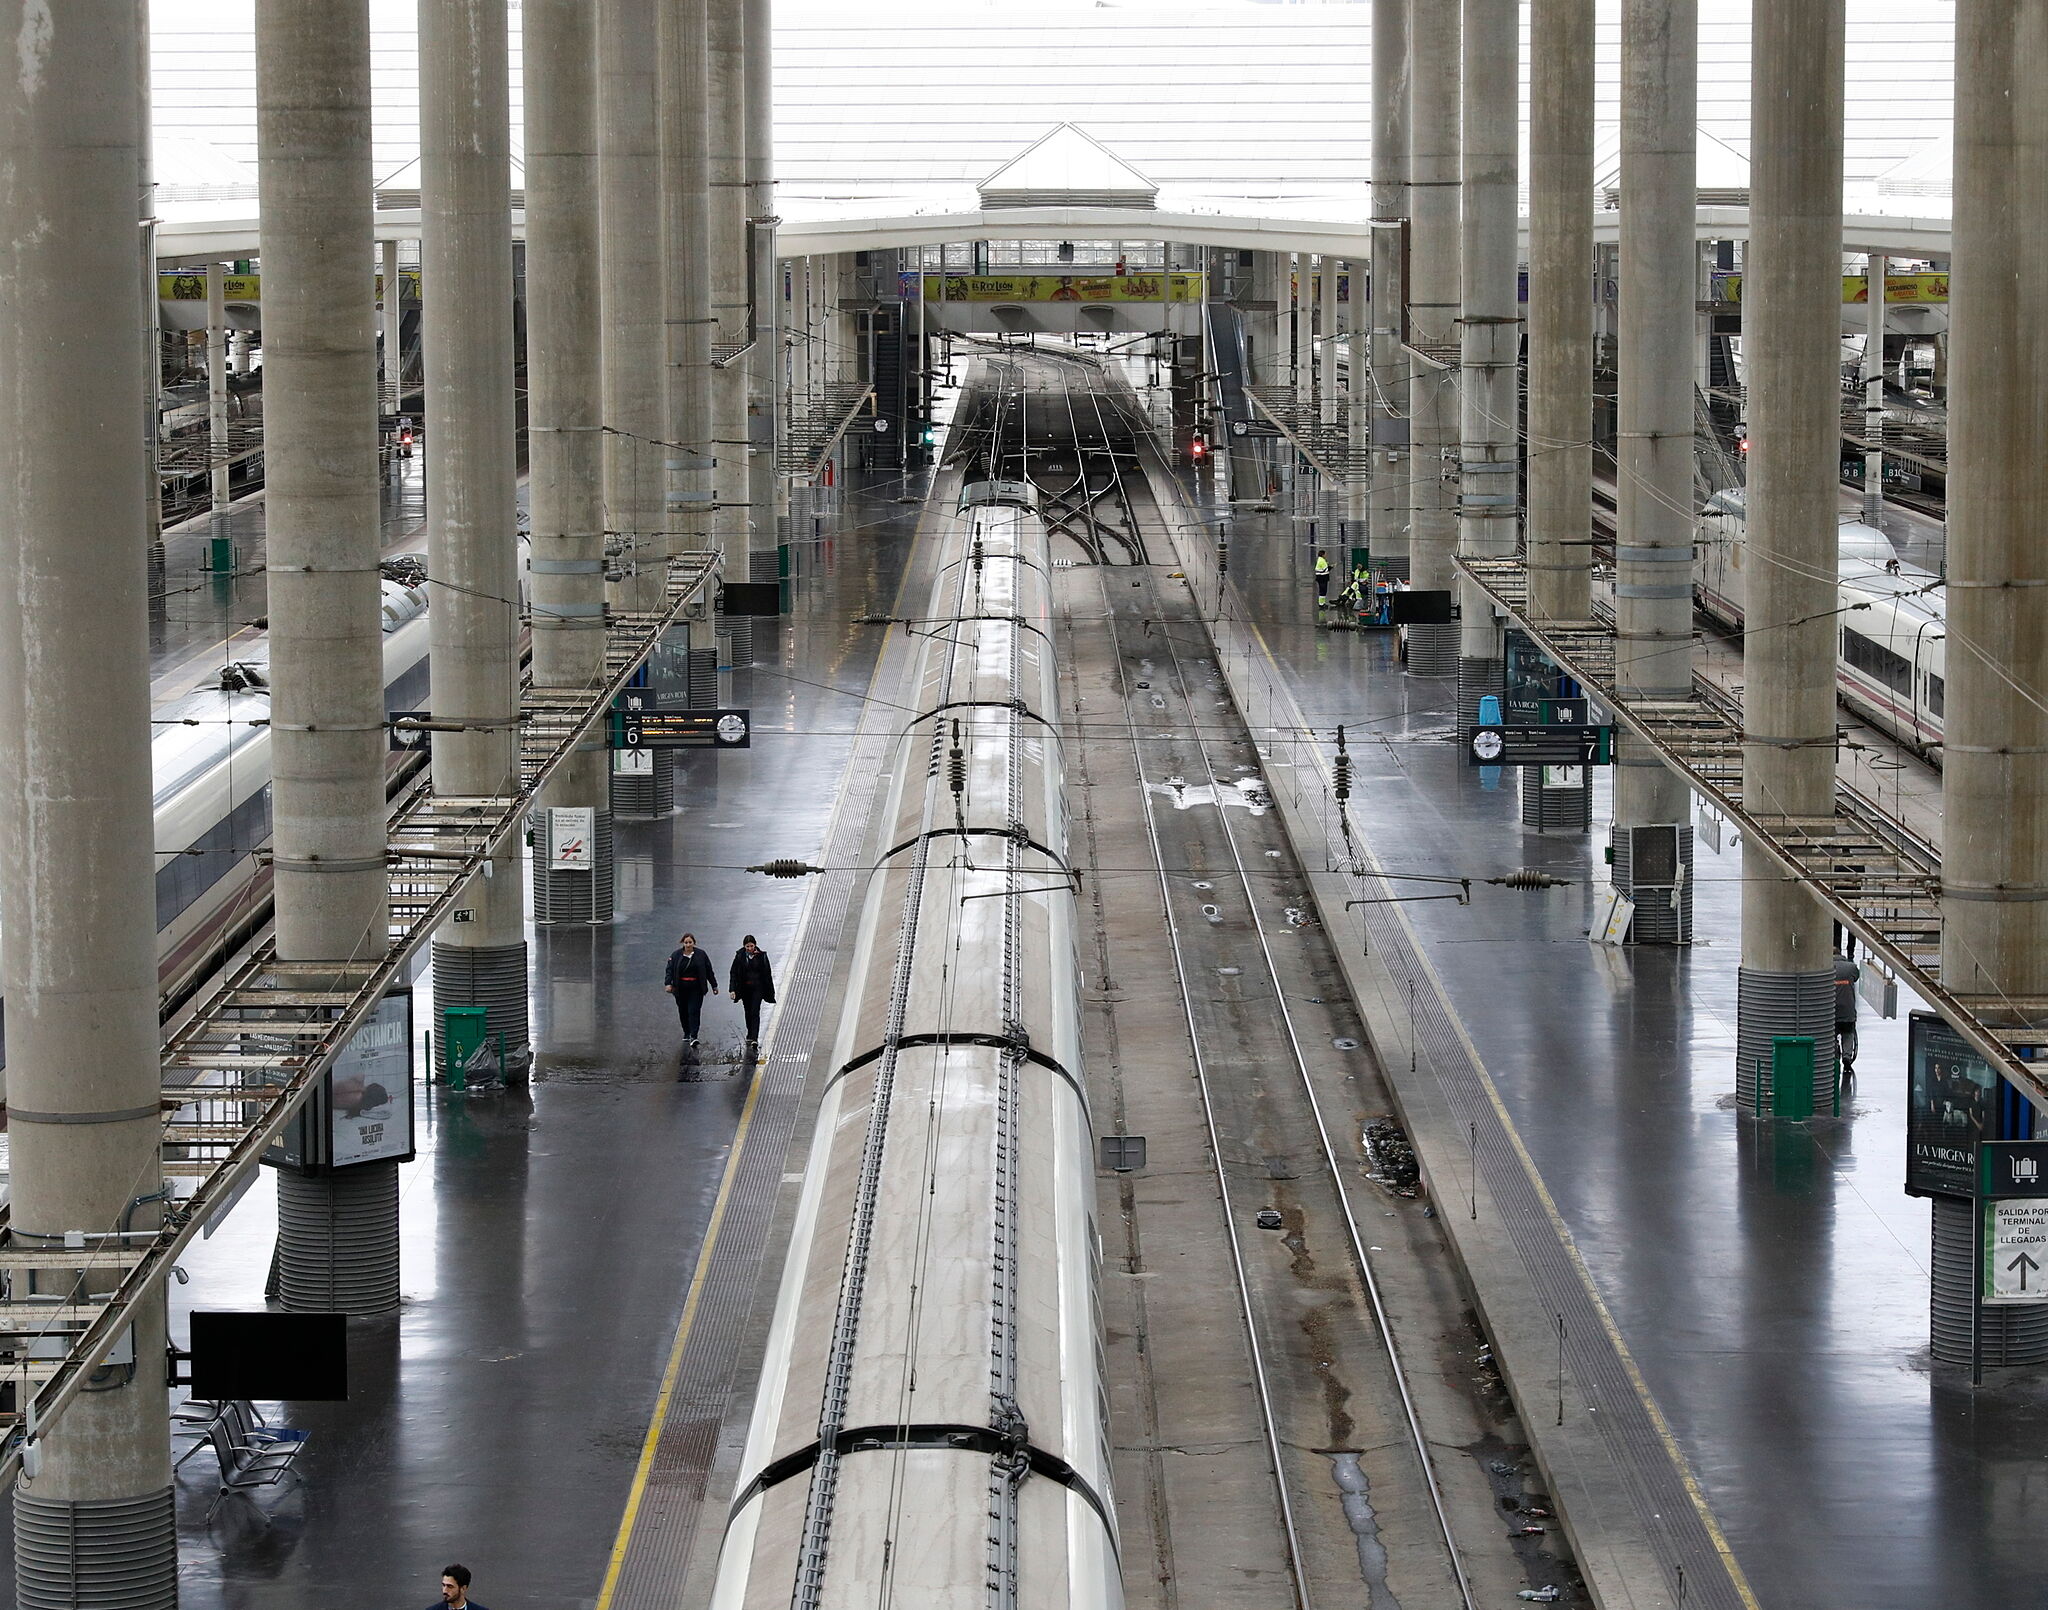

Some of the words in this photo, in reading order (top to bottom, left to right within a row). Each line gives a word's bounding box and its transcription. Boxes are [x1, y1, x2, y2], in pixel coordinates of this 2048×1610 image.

[972, 283, 980, 291] EL
[980, 282, 995, 292] REY
[995, 281, 1013, 292] LEÓN
[824, 463, 830, 471] 6
[1844, 469, 1850, 477] 9
[1853, 469, 1859, 477] B
[1888, 469, 1894, 477] B
[627, 727, 638, 744] 6
[1585, 742, 1596, 760] 7
[1916, 1143, 1929, 1157] LA
[1931, 1146, 1966, 1163] VIRGEN
[1998, 1208, 2030, 1216] SALIDA
[2032, 1208, 2048, 1216] POR
[2002, 1217, 2046, 1226] TERMINAL
[2018, 1227, 2030, 1235] DE
[2000, 1235, 2047, 1244] LLEGADAS
